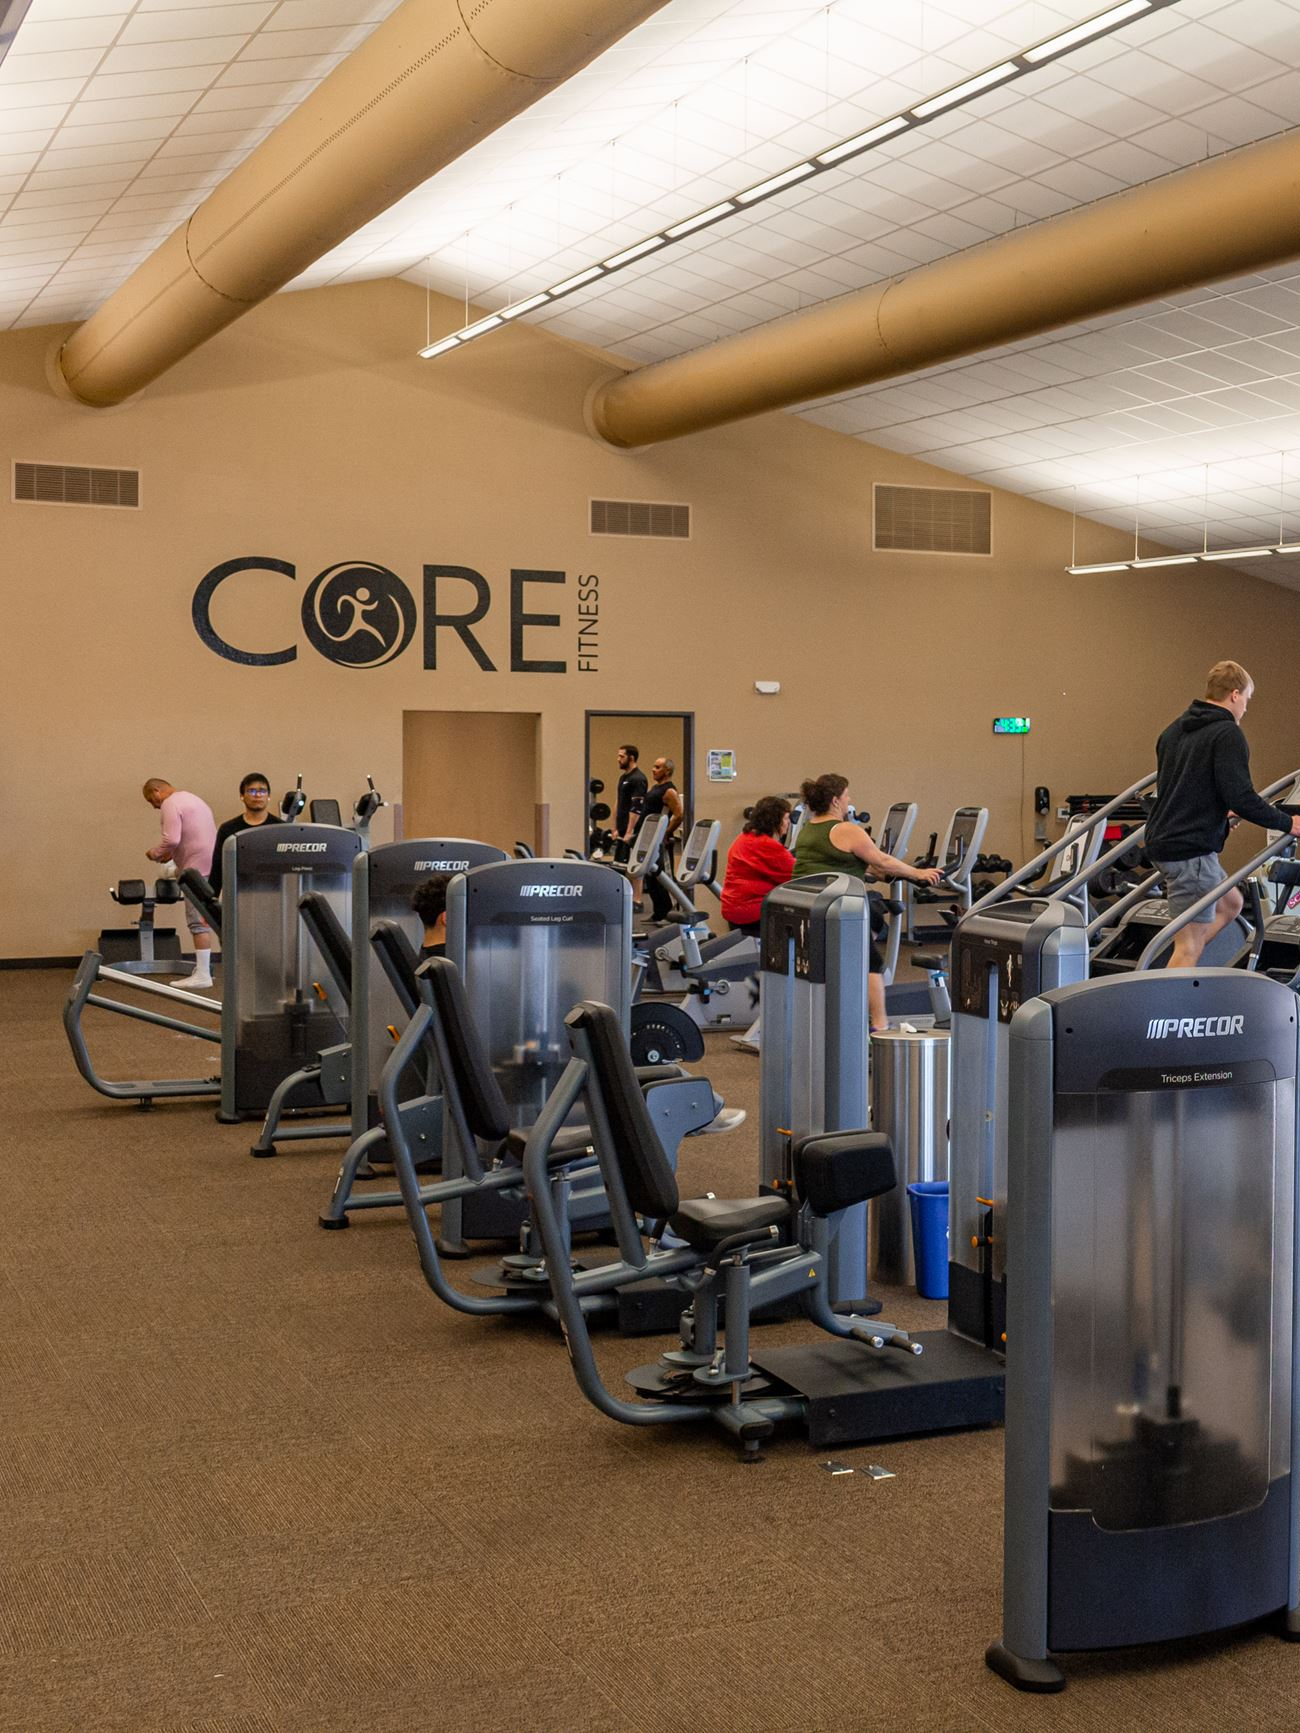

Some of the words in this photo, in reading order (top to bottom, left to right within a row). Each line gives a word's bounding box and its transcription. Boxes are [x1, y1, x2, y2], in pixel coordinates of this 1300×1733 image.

[192, 556, 567, 674] CORE
[578, 574, 599, 672] FITNESS
[284, 843, 328, 853] PRECOR
[423, 861, 470, 871] PRECOR
[530, 885, 583, 897] PRECOR
[1162, 1015, 1244, 1038] PRECOR
[1161, 1073, 1192, 1083] Triceps
[1194, 1071, 1233, 1082] Extension
